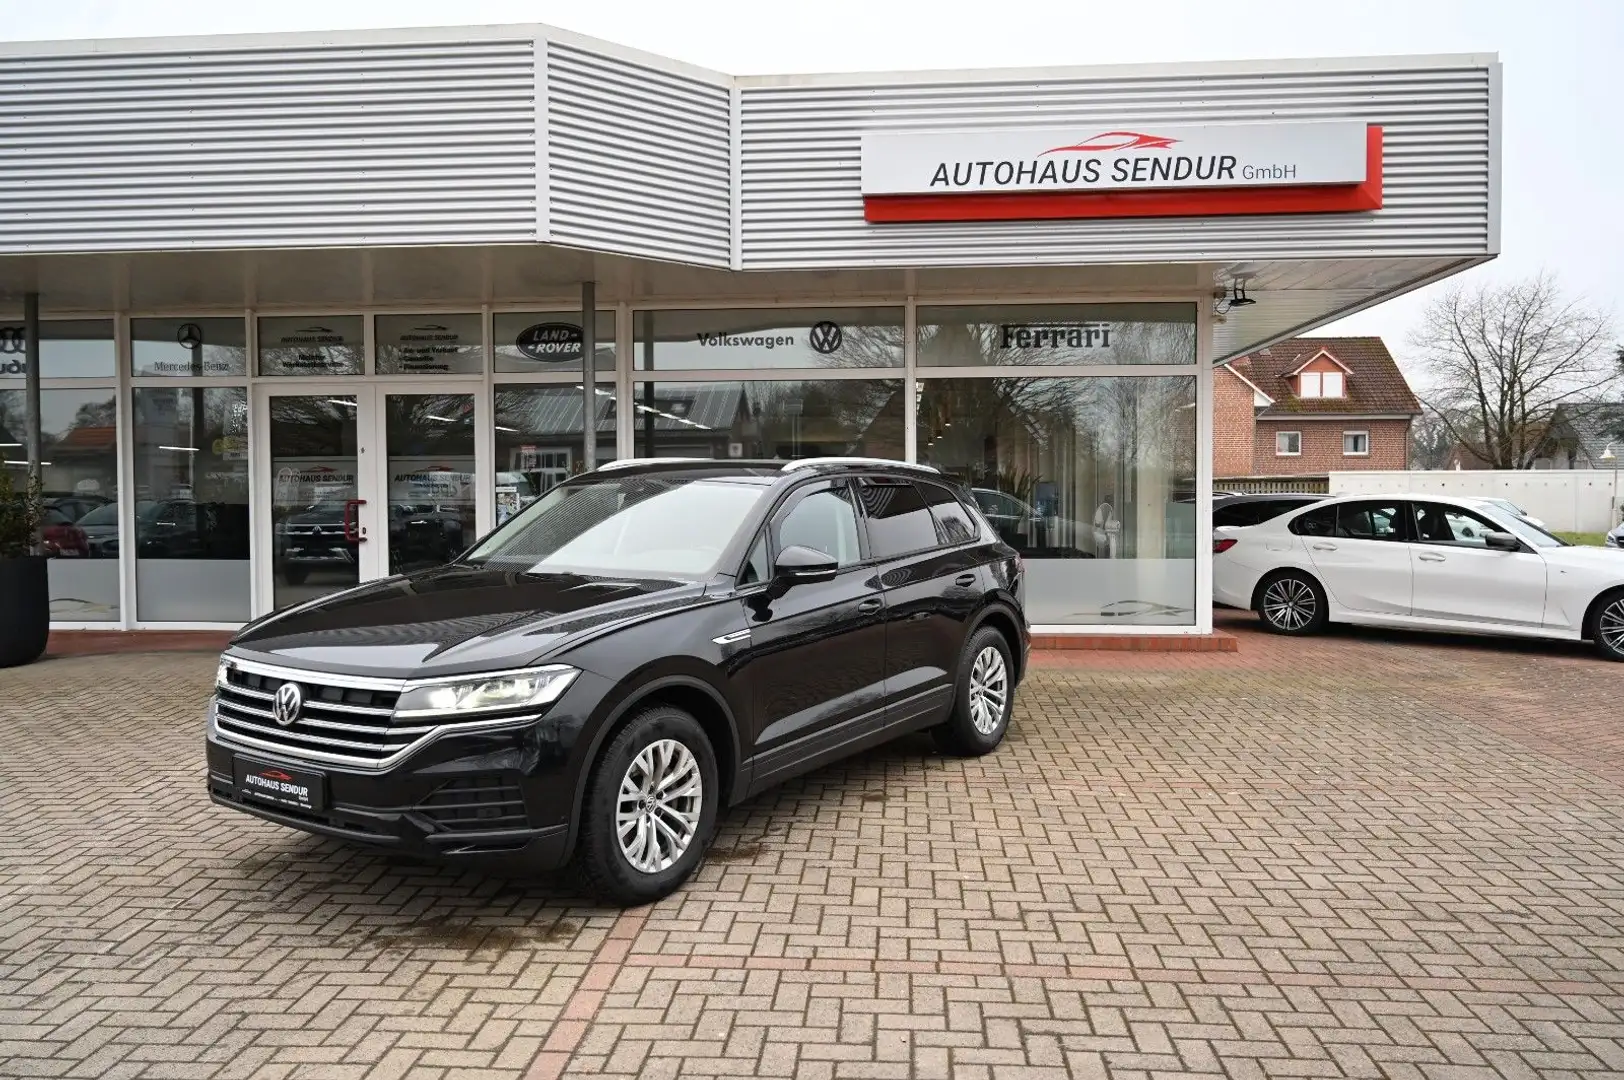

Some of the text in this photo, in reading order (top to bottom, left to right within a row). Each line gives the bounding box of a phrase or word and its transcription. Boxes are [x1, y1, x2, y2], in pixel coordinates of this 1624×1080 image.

[930, 155, 1296, 186] AUTOHAUS SENDUR GmbH
[697, 331, 794, 349] Volkswagen
[1000, 323, 1110, 349] Ferrari
[245, 774, 279, 790] AUTOHAUS
[280, 783, 308, 797] SENDUR
